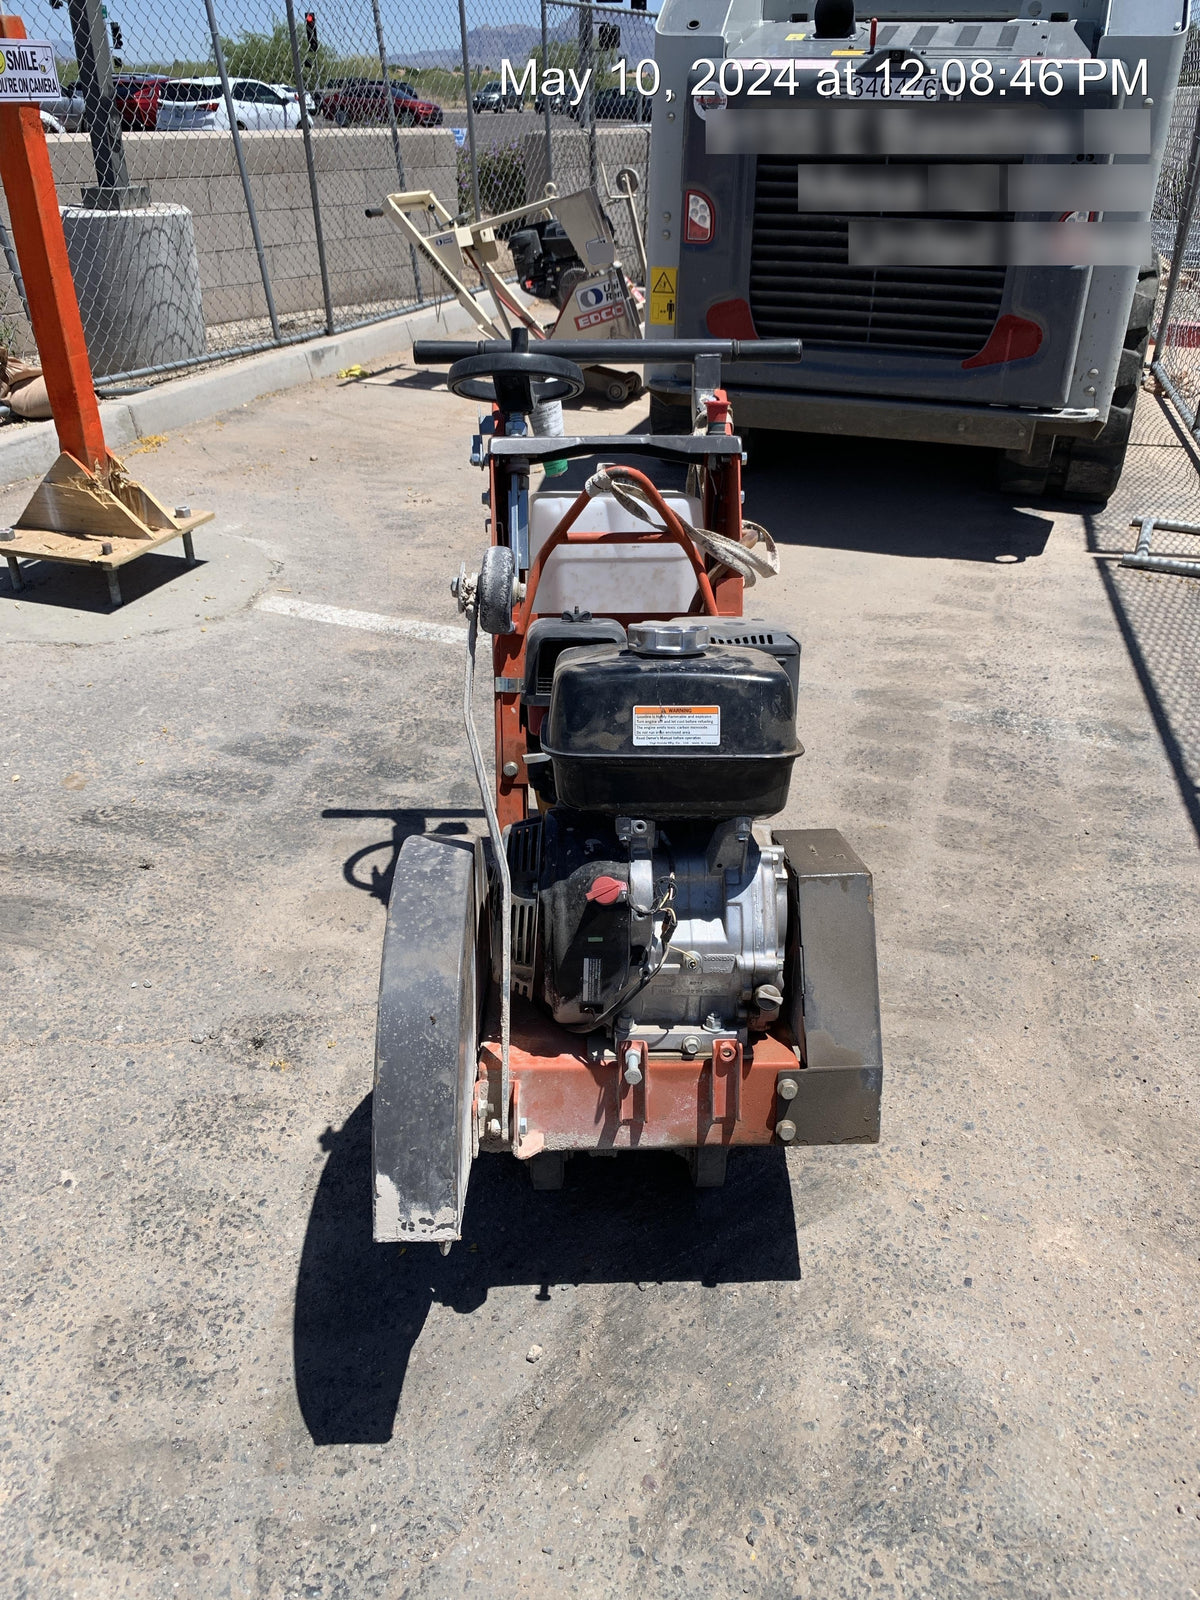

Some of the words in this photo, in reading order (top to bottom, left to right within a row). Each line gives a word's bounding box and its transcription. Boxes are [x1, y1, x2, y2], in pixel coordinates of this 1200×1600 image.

[6, 50, 39, 70] SMILE
[18, 77, 29, 93] ON
[29, 77, 58, 93] CAMERA
[577, 304, 625, 328] EDCO
